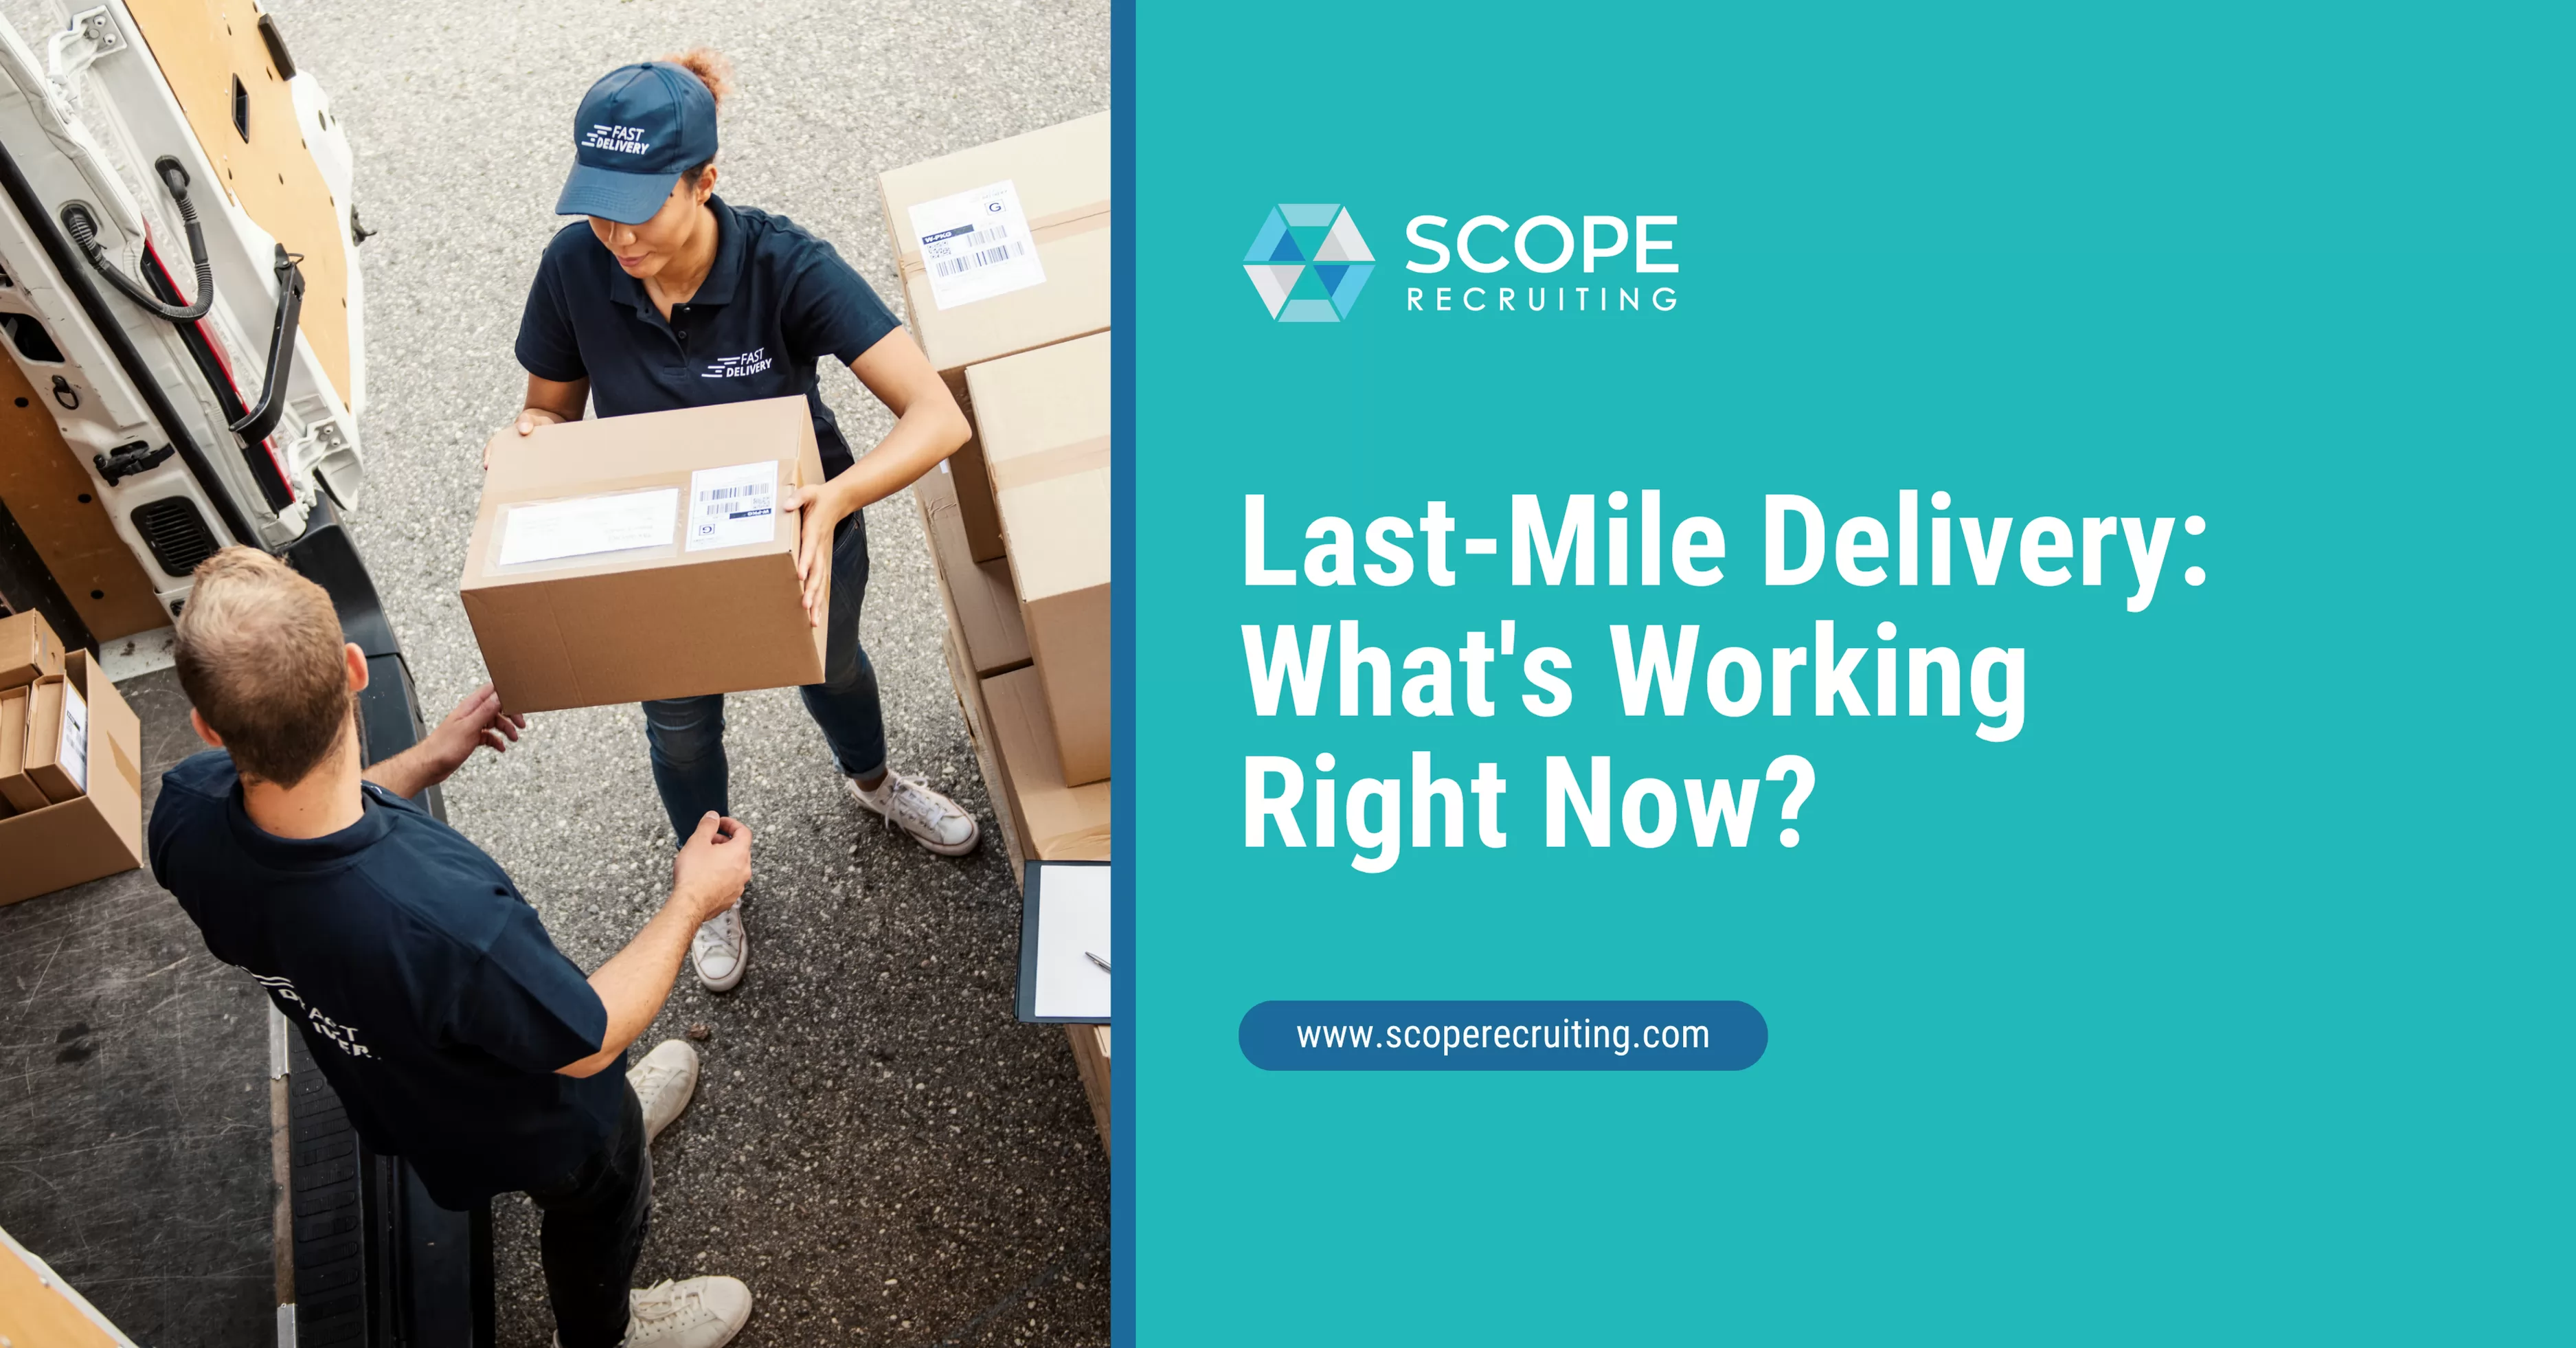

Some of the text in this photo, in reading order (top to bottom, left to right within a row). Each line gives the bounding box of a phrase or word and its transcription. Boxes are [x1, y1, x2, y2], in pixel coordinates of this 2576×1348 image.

[612, 125, 644, 142] FAST
[596, 137, 649, 155] DELIVERY
[988, 202, 1002, 212] G
[741, 347, 765, 365] FAST
[726, 358, 772, 377] DELIVERY
